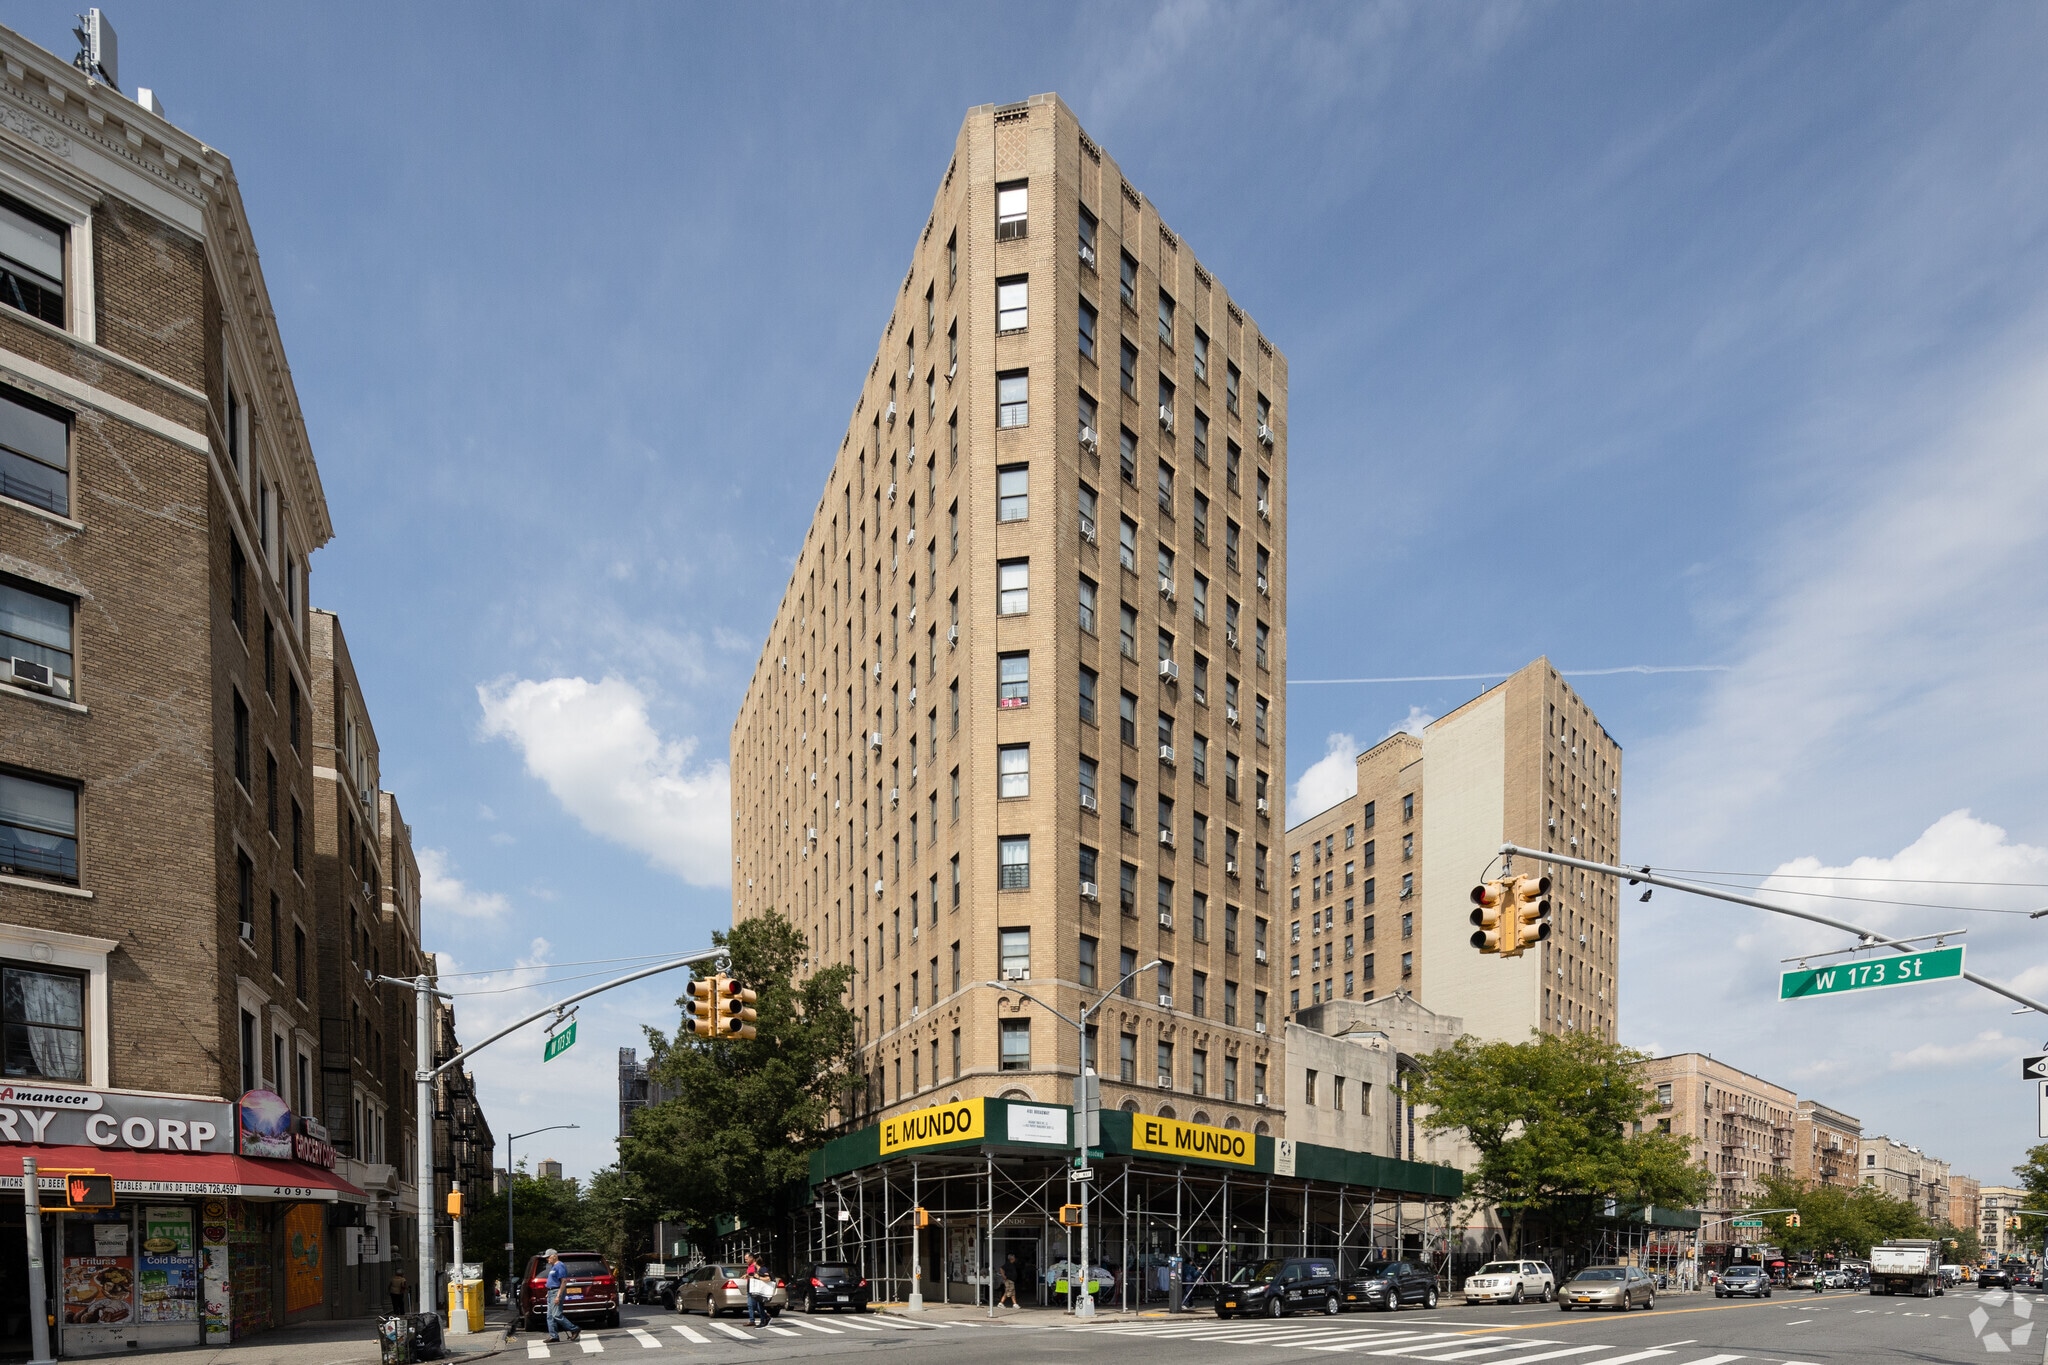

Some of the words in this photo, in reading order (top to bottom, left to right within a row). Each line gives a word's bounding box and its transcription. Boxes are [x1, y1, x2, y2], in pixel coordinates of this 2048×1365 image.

[1815, 970, 1836, 990] W
[1847, 964, 1885, 986] 173
[1897, 958, 1923, 979] St
[0, 1087, 88, 1104] Amanecer
[85, 1113, 217, 1151] CORP
[886, 1124, 899, 1147] EL
[902, 1108, 972, 1143] MUNDO
[1145, 1122, 1169, 1146] EL
[1175, 1127, 1245, 1158] MUNDO
[0, 1177, 23, 1187] WICHS
[149, 1182, 161, 1191] ATM
[273, 1187, 312, 1196] 4099
[151, 1226, 189, 1238] ATM
[147, 1256, 169, 1265] Cold
[170, 1256, 196, 1265] Beers
